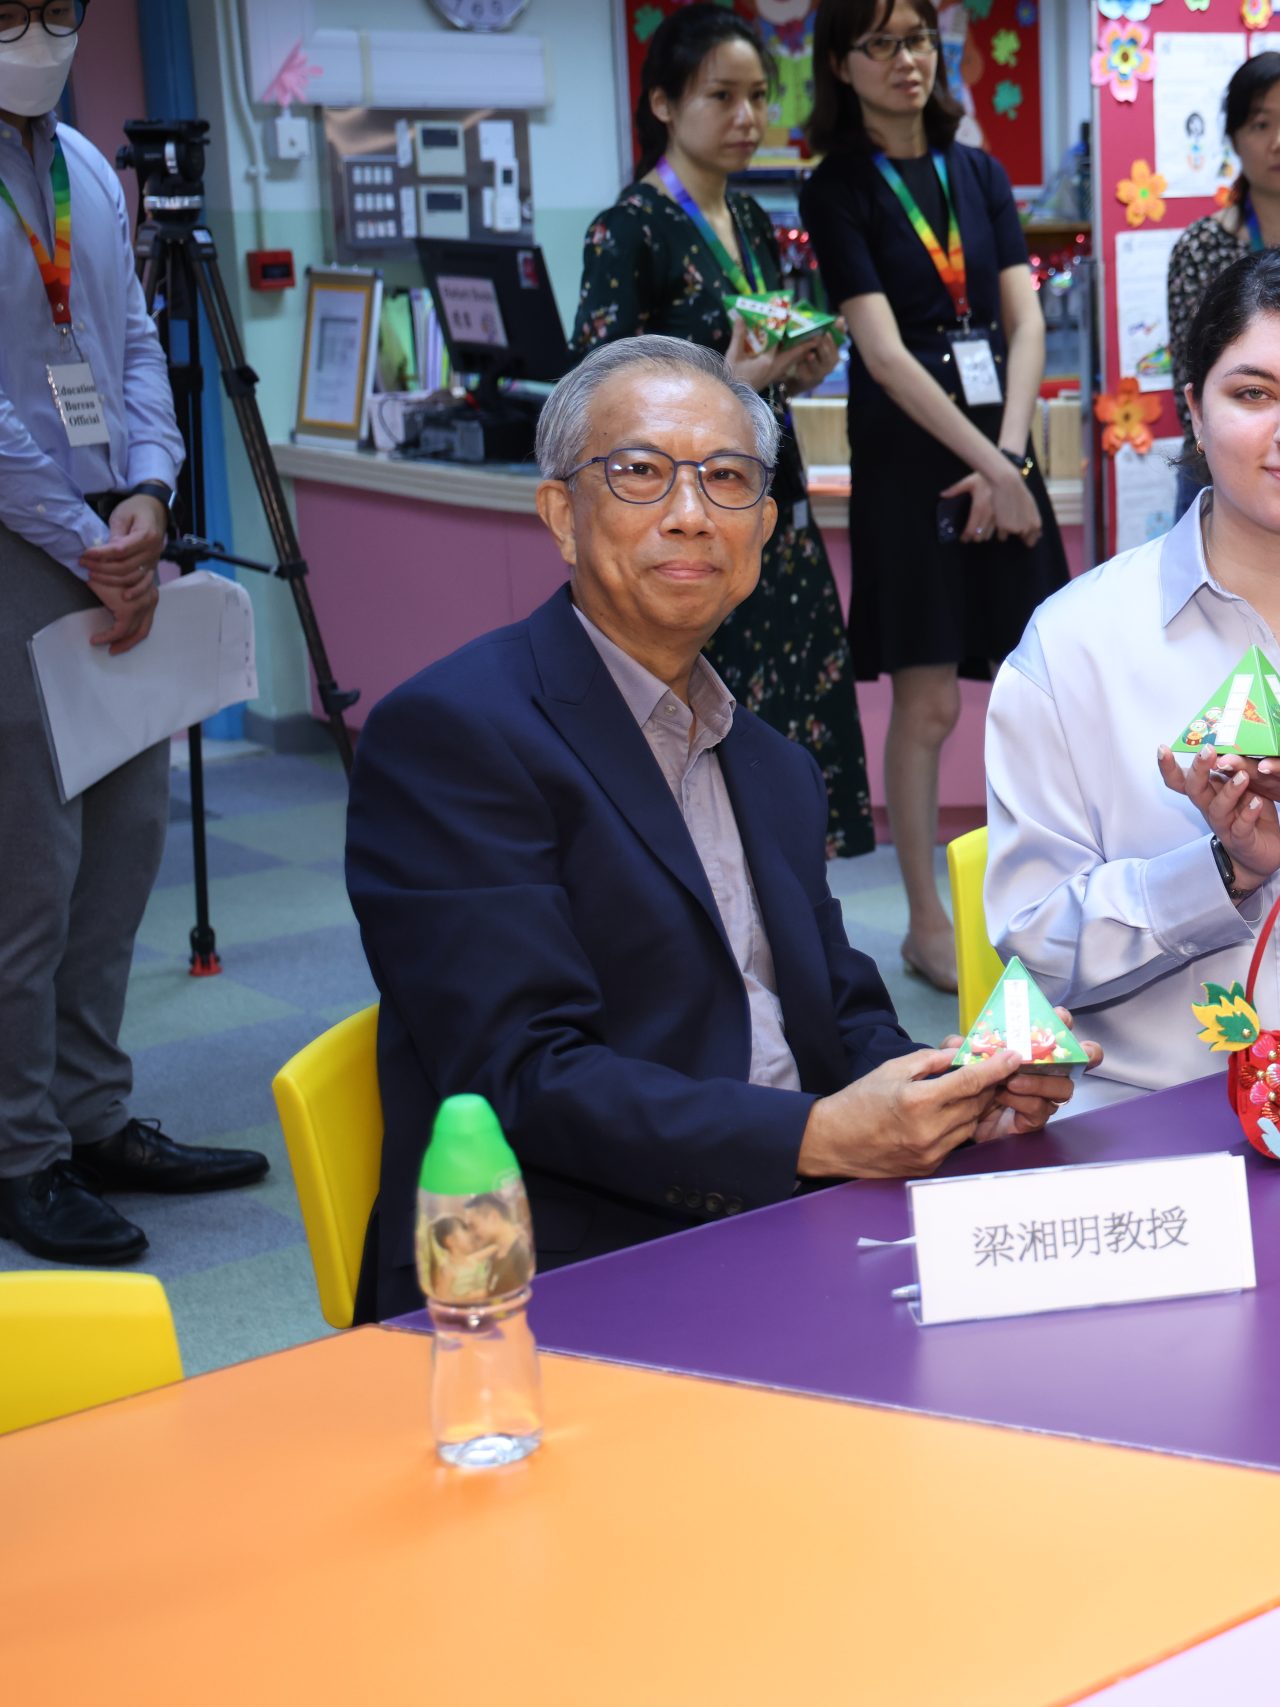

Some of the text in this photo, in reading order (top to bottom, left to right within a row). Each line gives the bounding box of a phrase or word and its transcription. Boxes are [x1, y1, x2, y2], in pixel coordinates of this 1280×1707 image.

[65, 401, 95, 411] Bureau
[69, 413, 100, 427] Official
[972, 1205, 1190, 1267] 梁湘明教授
